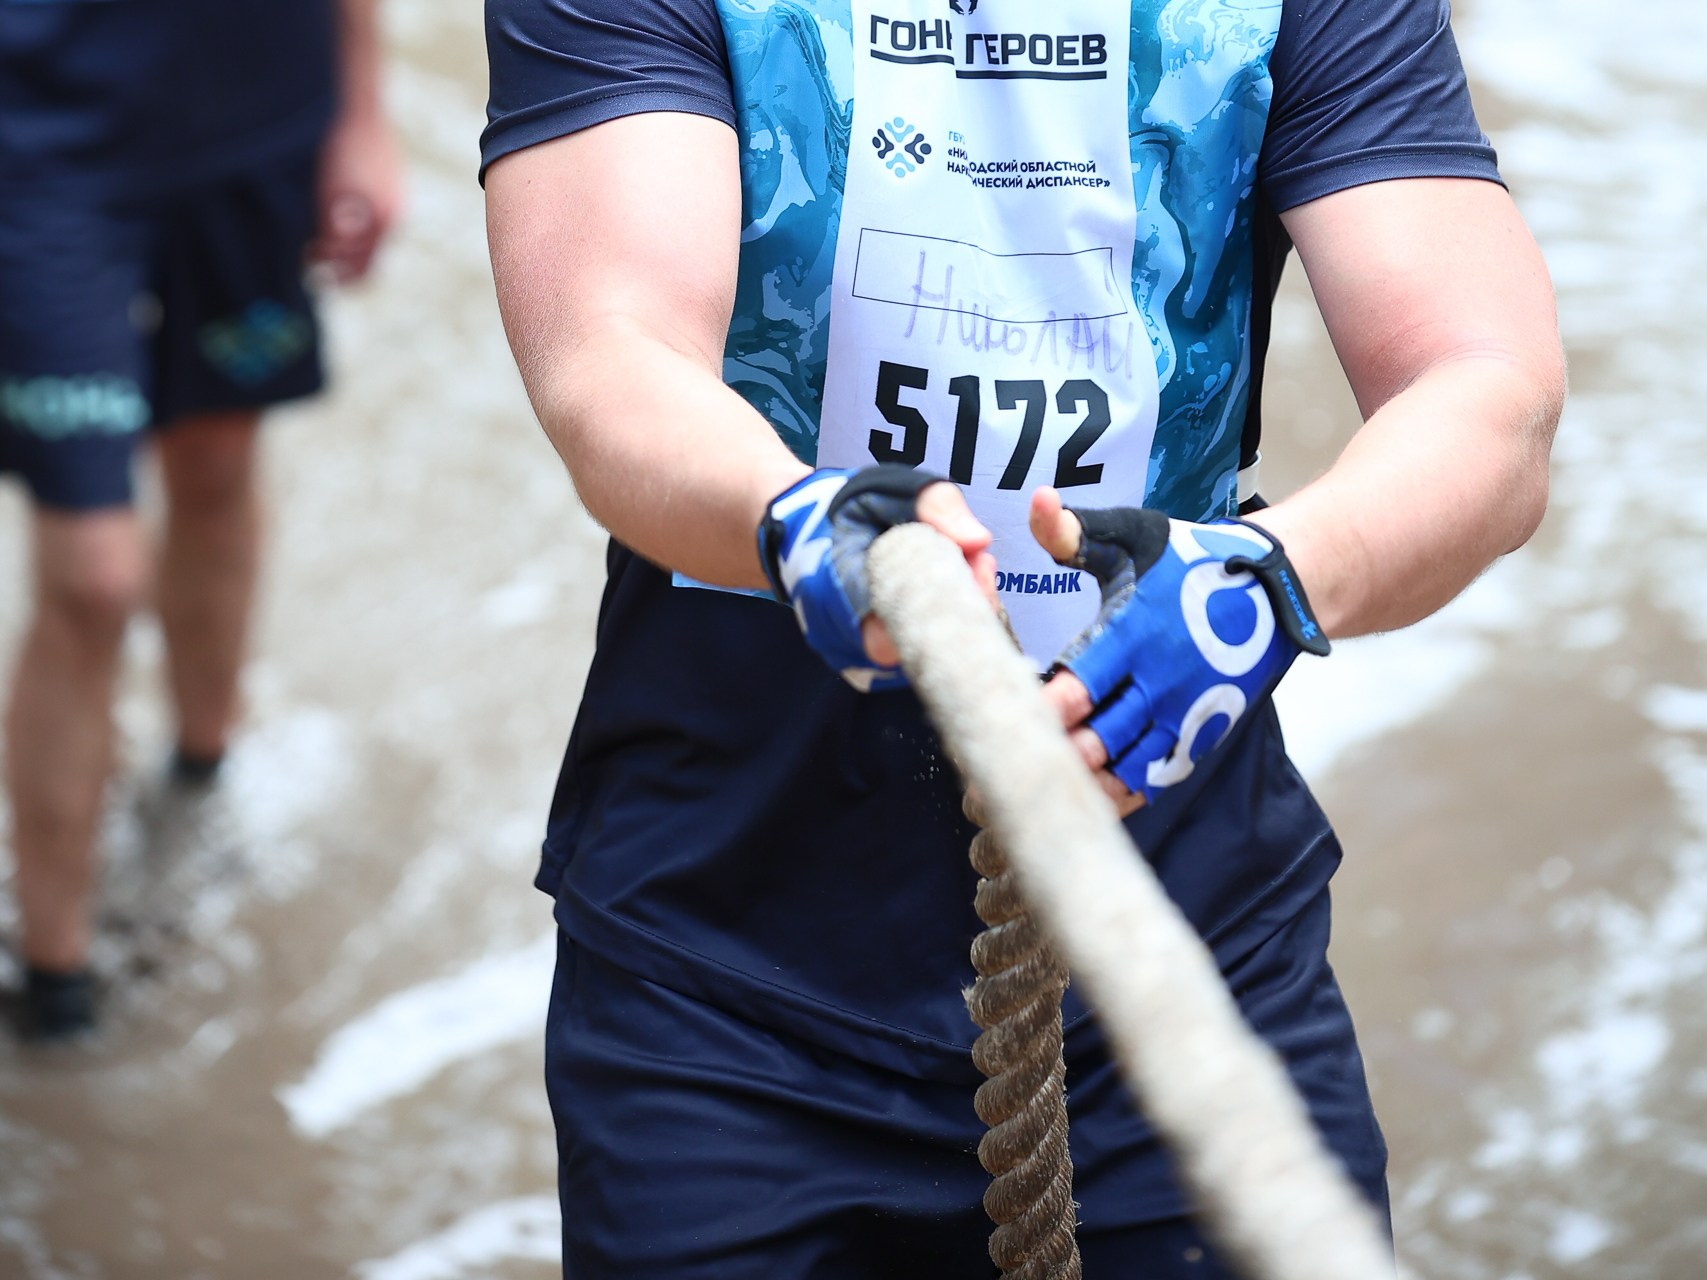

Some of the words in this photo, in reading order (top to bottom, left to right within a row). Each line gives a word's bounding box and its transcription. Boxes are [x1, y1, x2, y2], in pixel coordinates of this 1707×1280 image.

[965, 33, 1107, 66] ГЕРОЕВ
[948, 130, 966, 145] ГБУ
[1020, 160, 1096, 174] ОБЛАСТНОЙ
[1025, 176, 1111, 189] ДИСПАНСЕР»
[868, 360, 1112, 490] 5172
